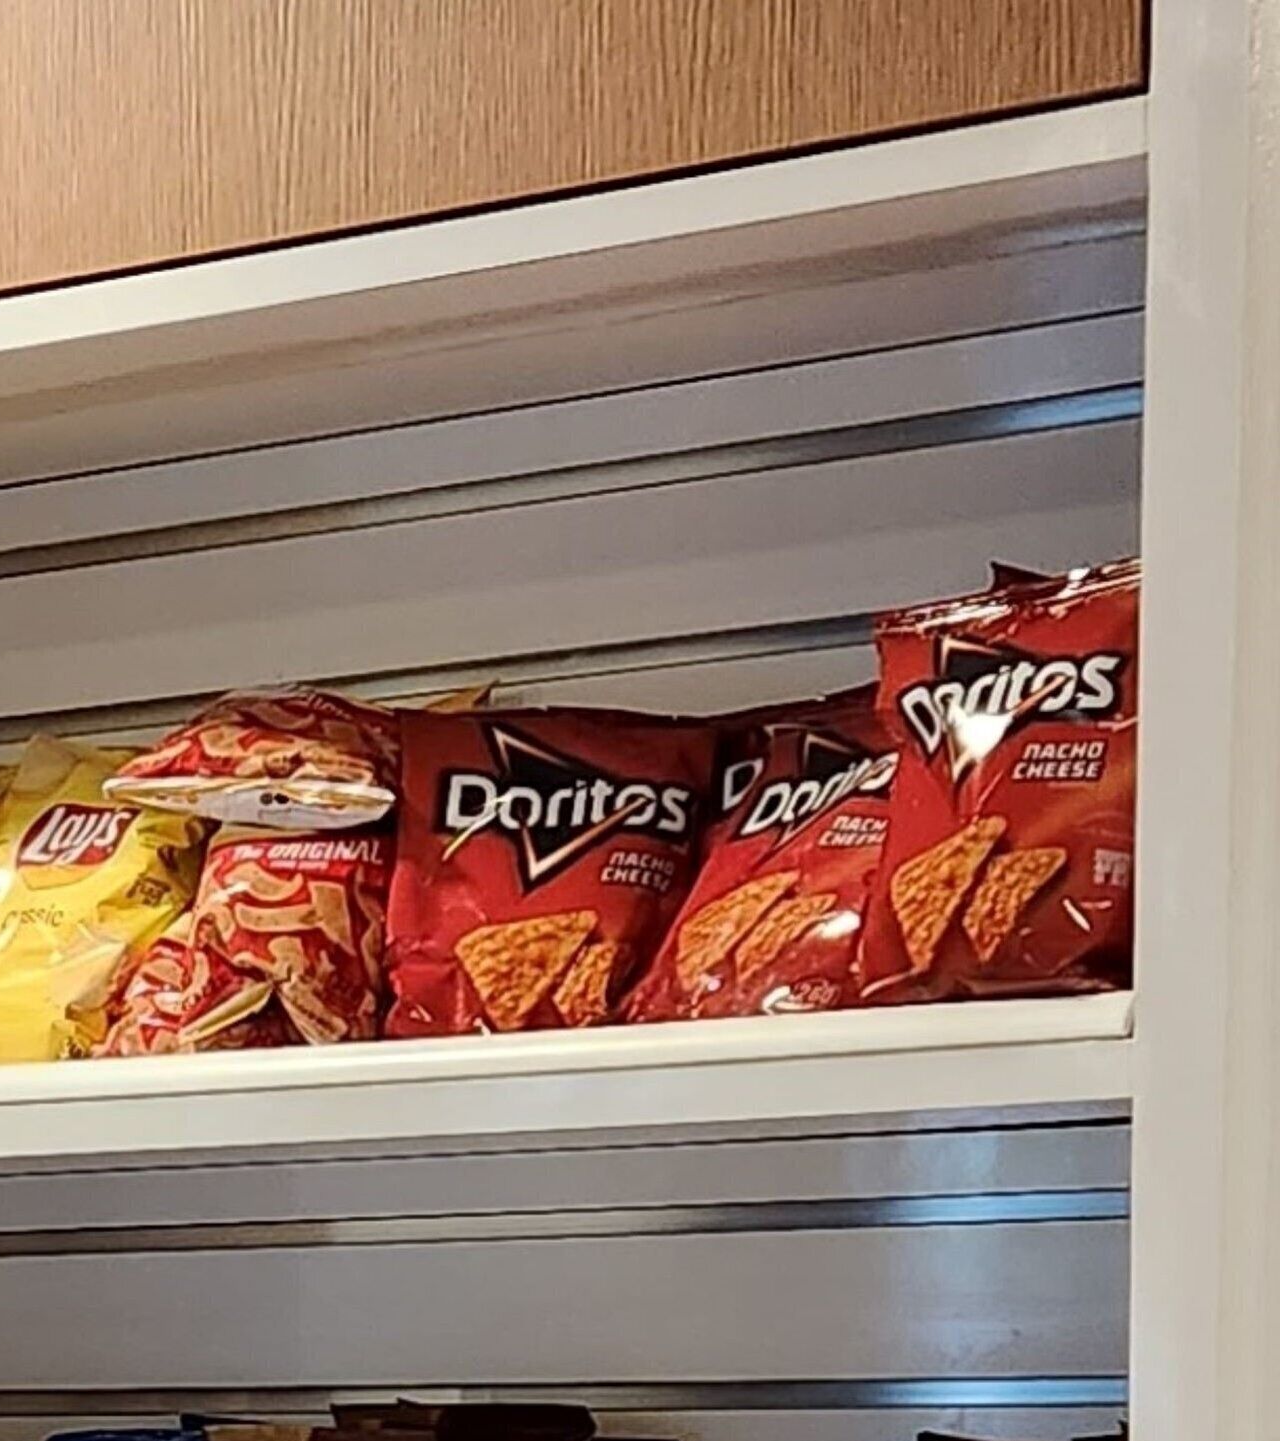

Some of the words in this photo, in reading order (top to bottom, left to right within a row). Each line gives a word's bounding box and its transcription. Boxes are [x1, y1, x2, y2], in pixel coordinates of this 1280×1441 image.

[901, 655, 1121, 755] Doritos
[1023, 742, 1105, 760] NACHO
[1012, 761, 1101, 780] CHEESE
[445, 773, 690, 833] Doritos
[271, 839, 384, 865] ORIGINAL
[609, 851, 675, 874] NACHO
